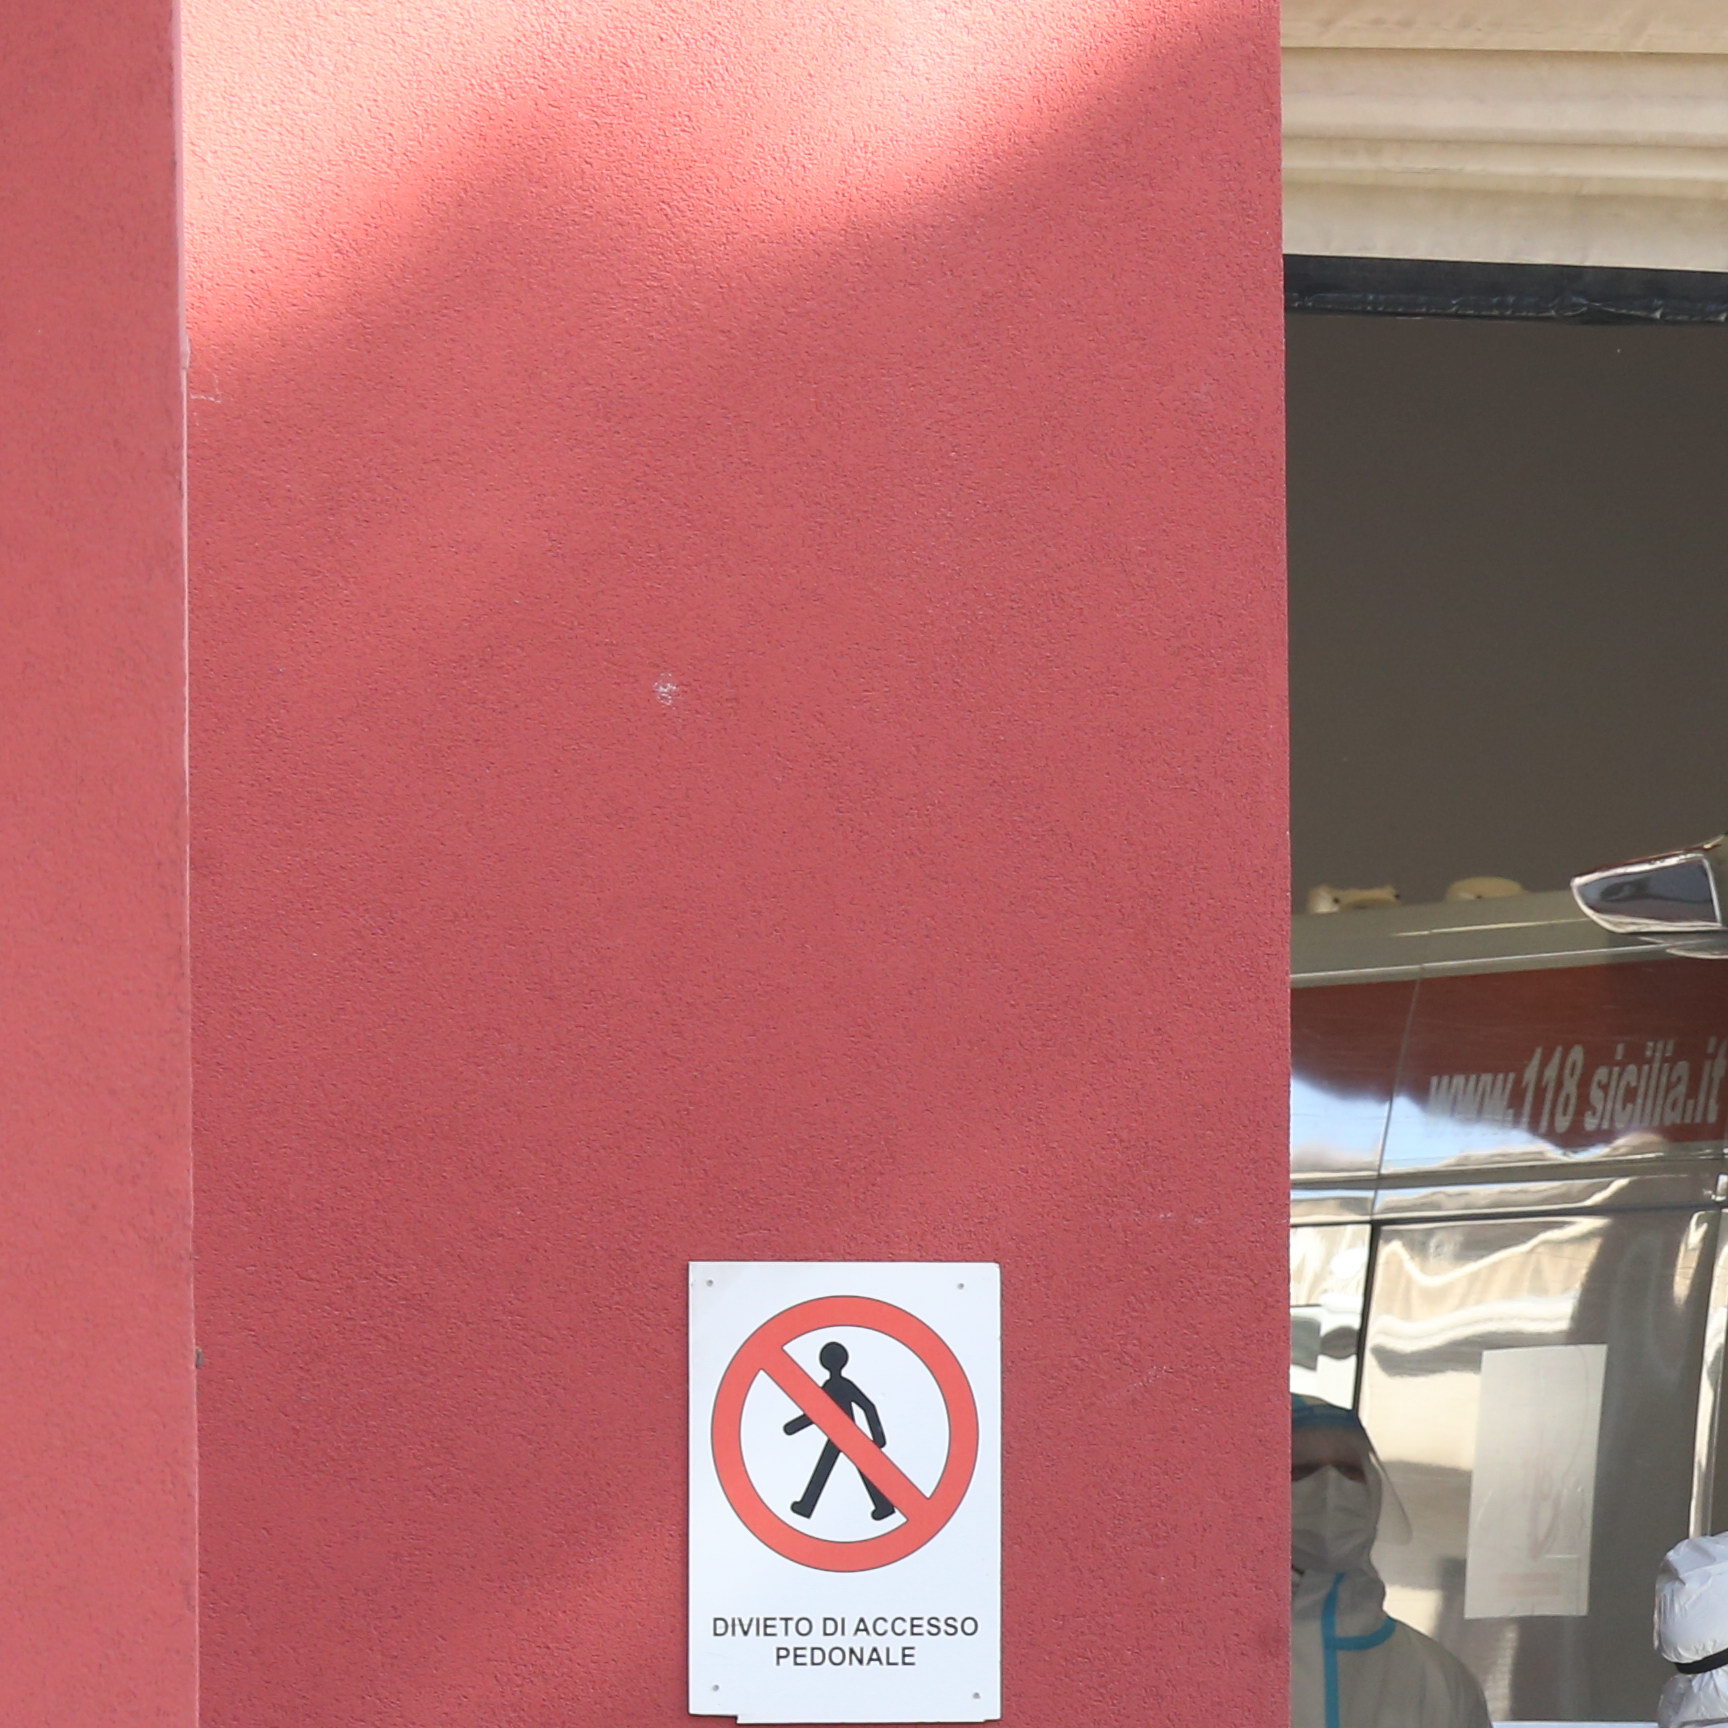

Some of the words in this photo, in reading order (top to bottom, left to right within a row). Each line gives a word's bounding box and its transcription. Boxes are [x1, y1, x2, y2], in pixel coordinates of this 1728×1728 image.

[712, 1616, 814, 1638] DIVIETO
[822, 1616, 848, 1637] DI
[853, 1616, 979, 1638] ACCESSO
[775, 1646, 917, 1668] PEDONALE
